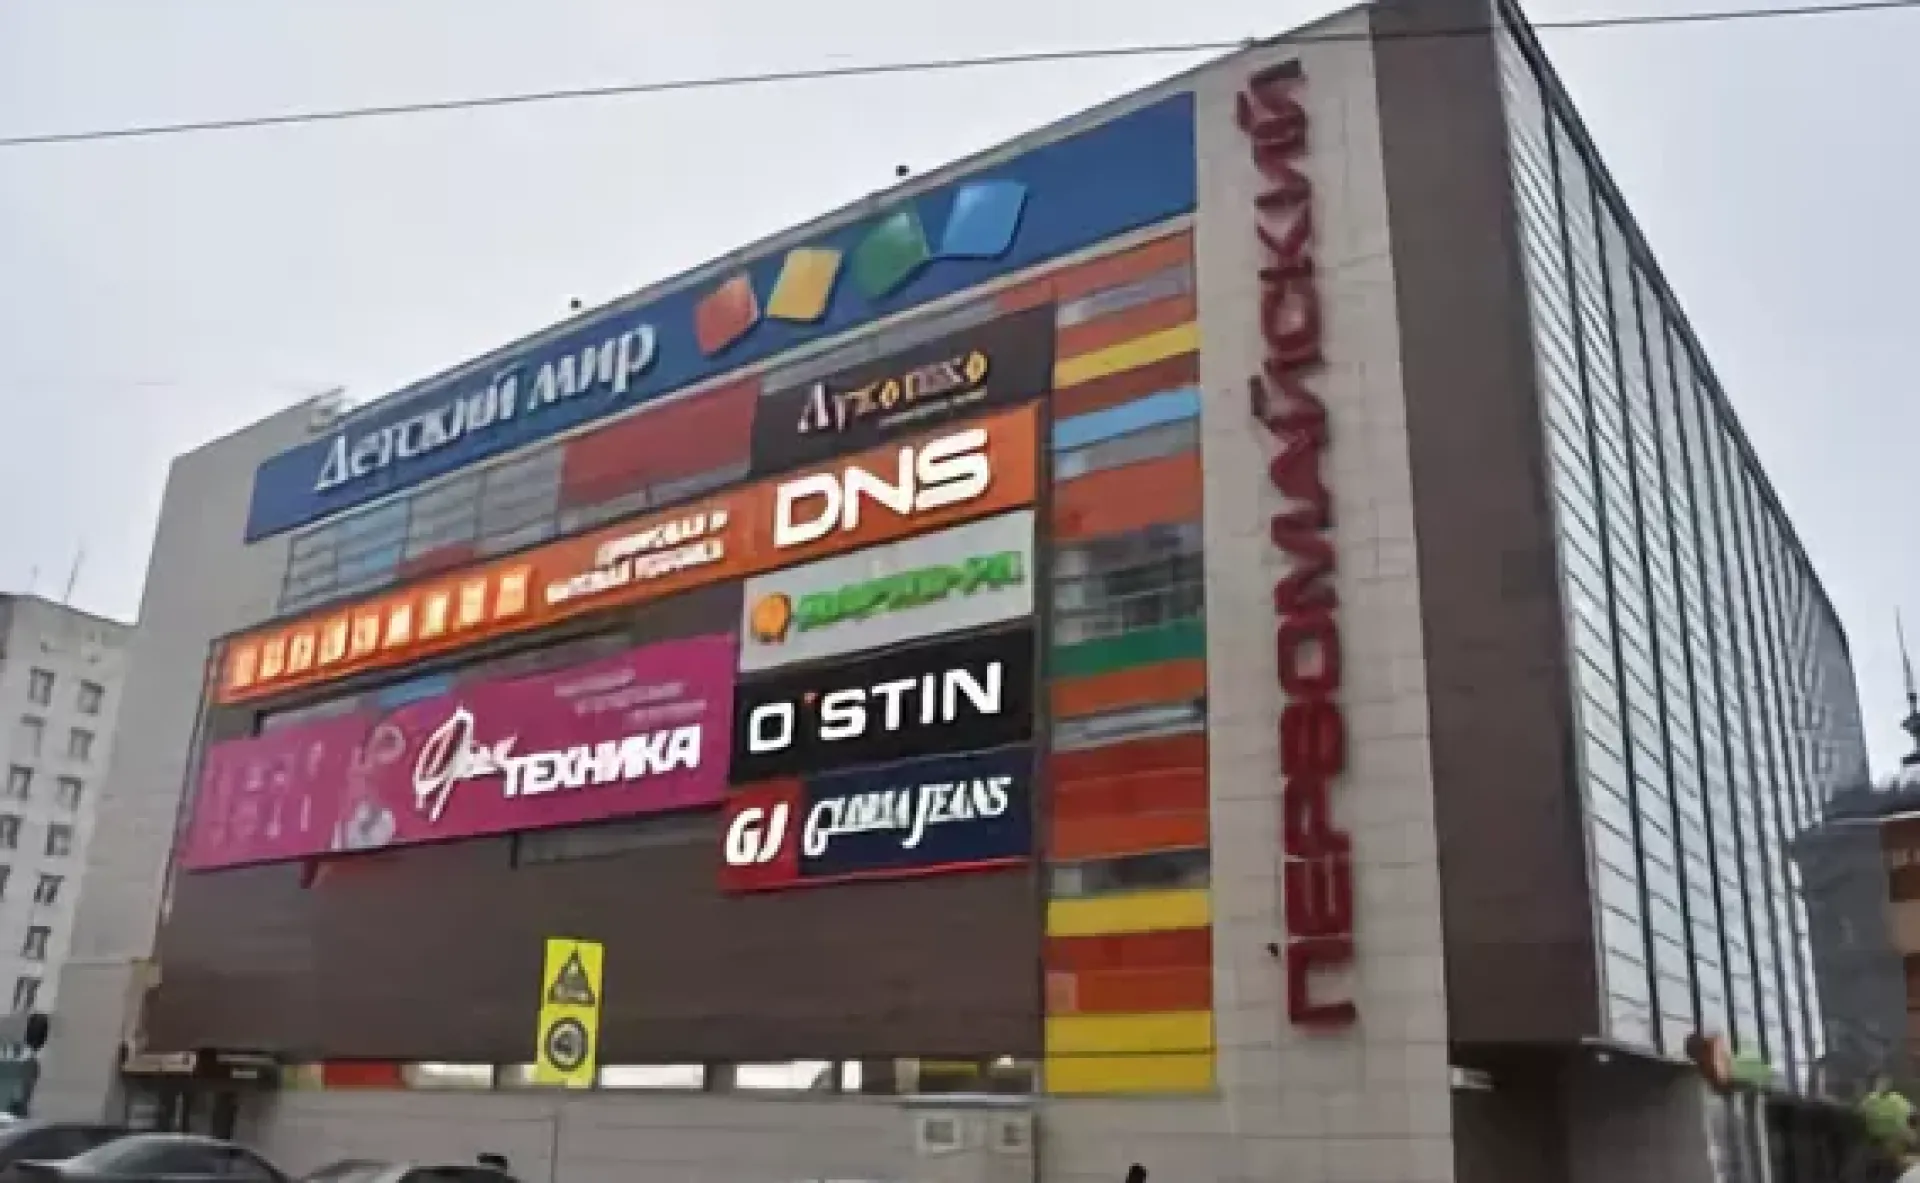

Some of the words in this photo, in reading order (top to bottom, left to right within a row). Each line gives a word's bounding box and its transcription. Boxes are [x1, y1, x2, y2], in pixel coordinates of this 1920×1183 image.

[314, 364, 519, 491] Детский
[526, 323, 657, 411] мир
[773, 428, 990, 547] DNS
[1237, 58, 1357, 1027] ПЕРВОМАЙСКИЙ
[503, 724, 702, 798] ТЕХНИКА
[725, 801, 790, 866] GJ
